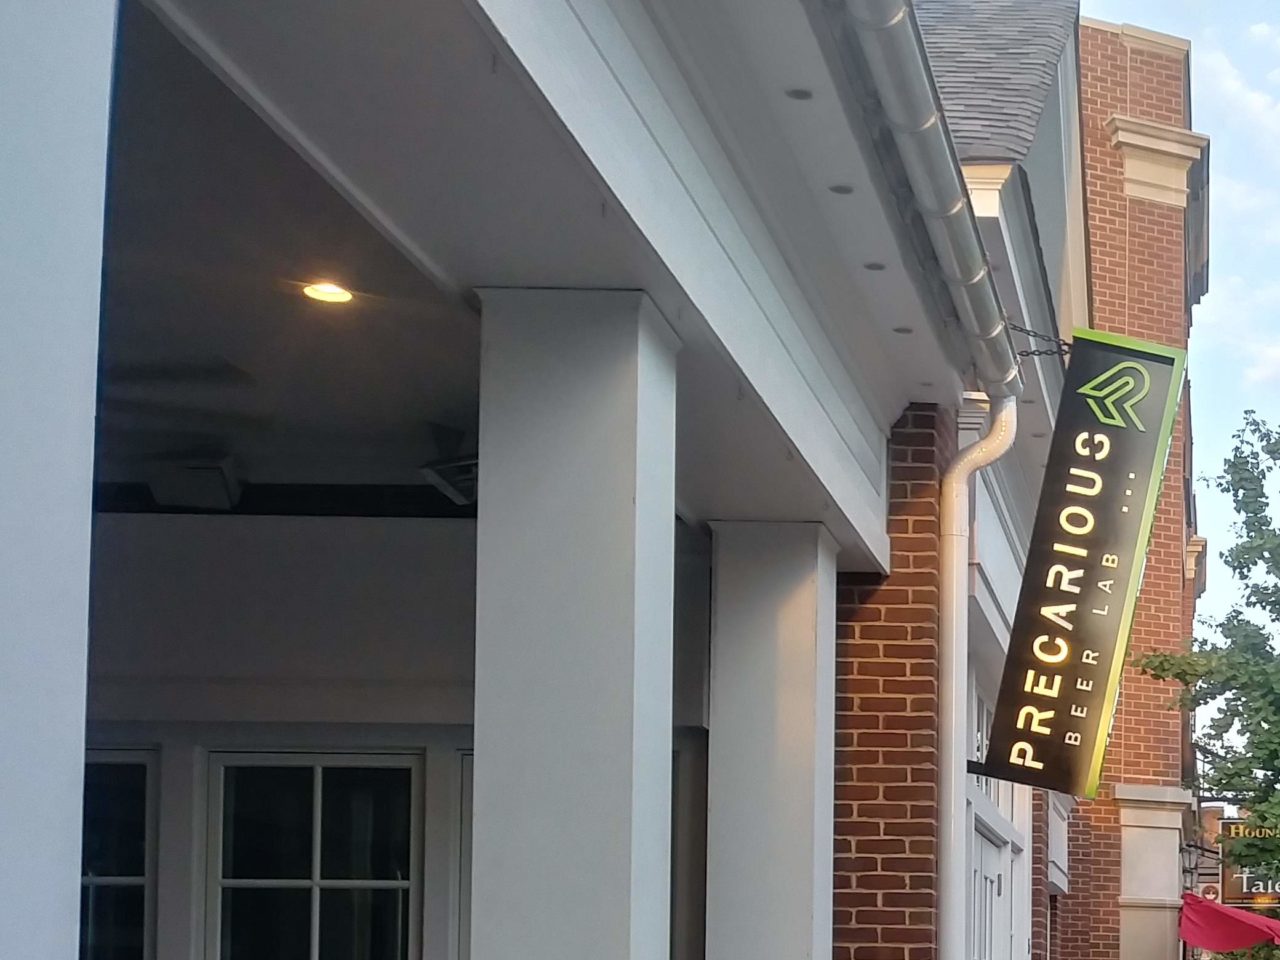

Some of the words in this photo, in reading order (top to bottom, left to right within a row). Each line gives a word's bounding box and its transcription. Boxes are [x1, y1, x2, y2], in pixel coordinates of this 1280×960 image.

[1009, 431, 1111, 770] PRECARIOUS
[1064, 649, 1100, 746] BEER
[1092, 553, 1119, 616] LAB
